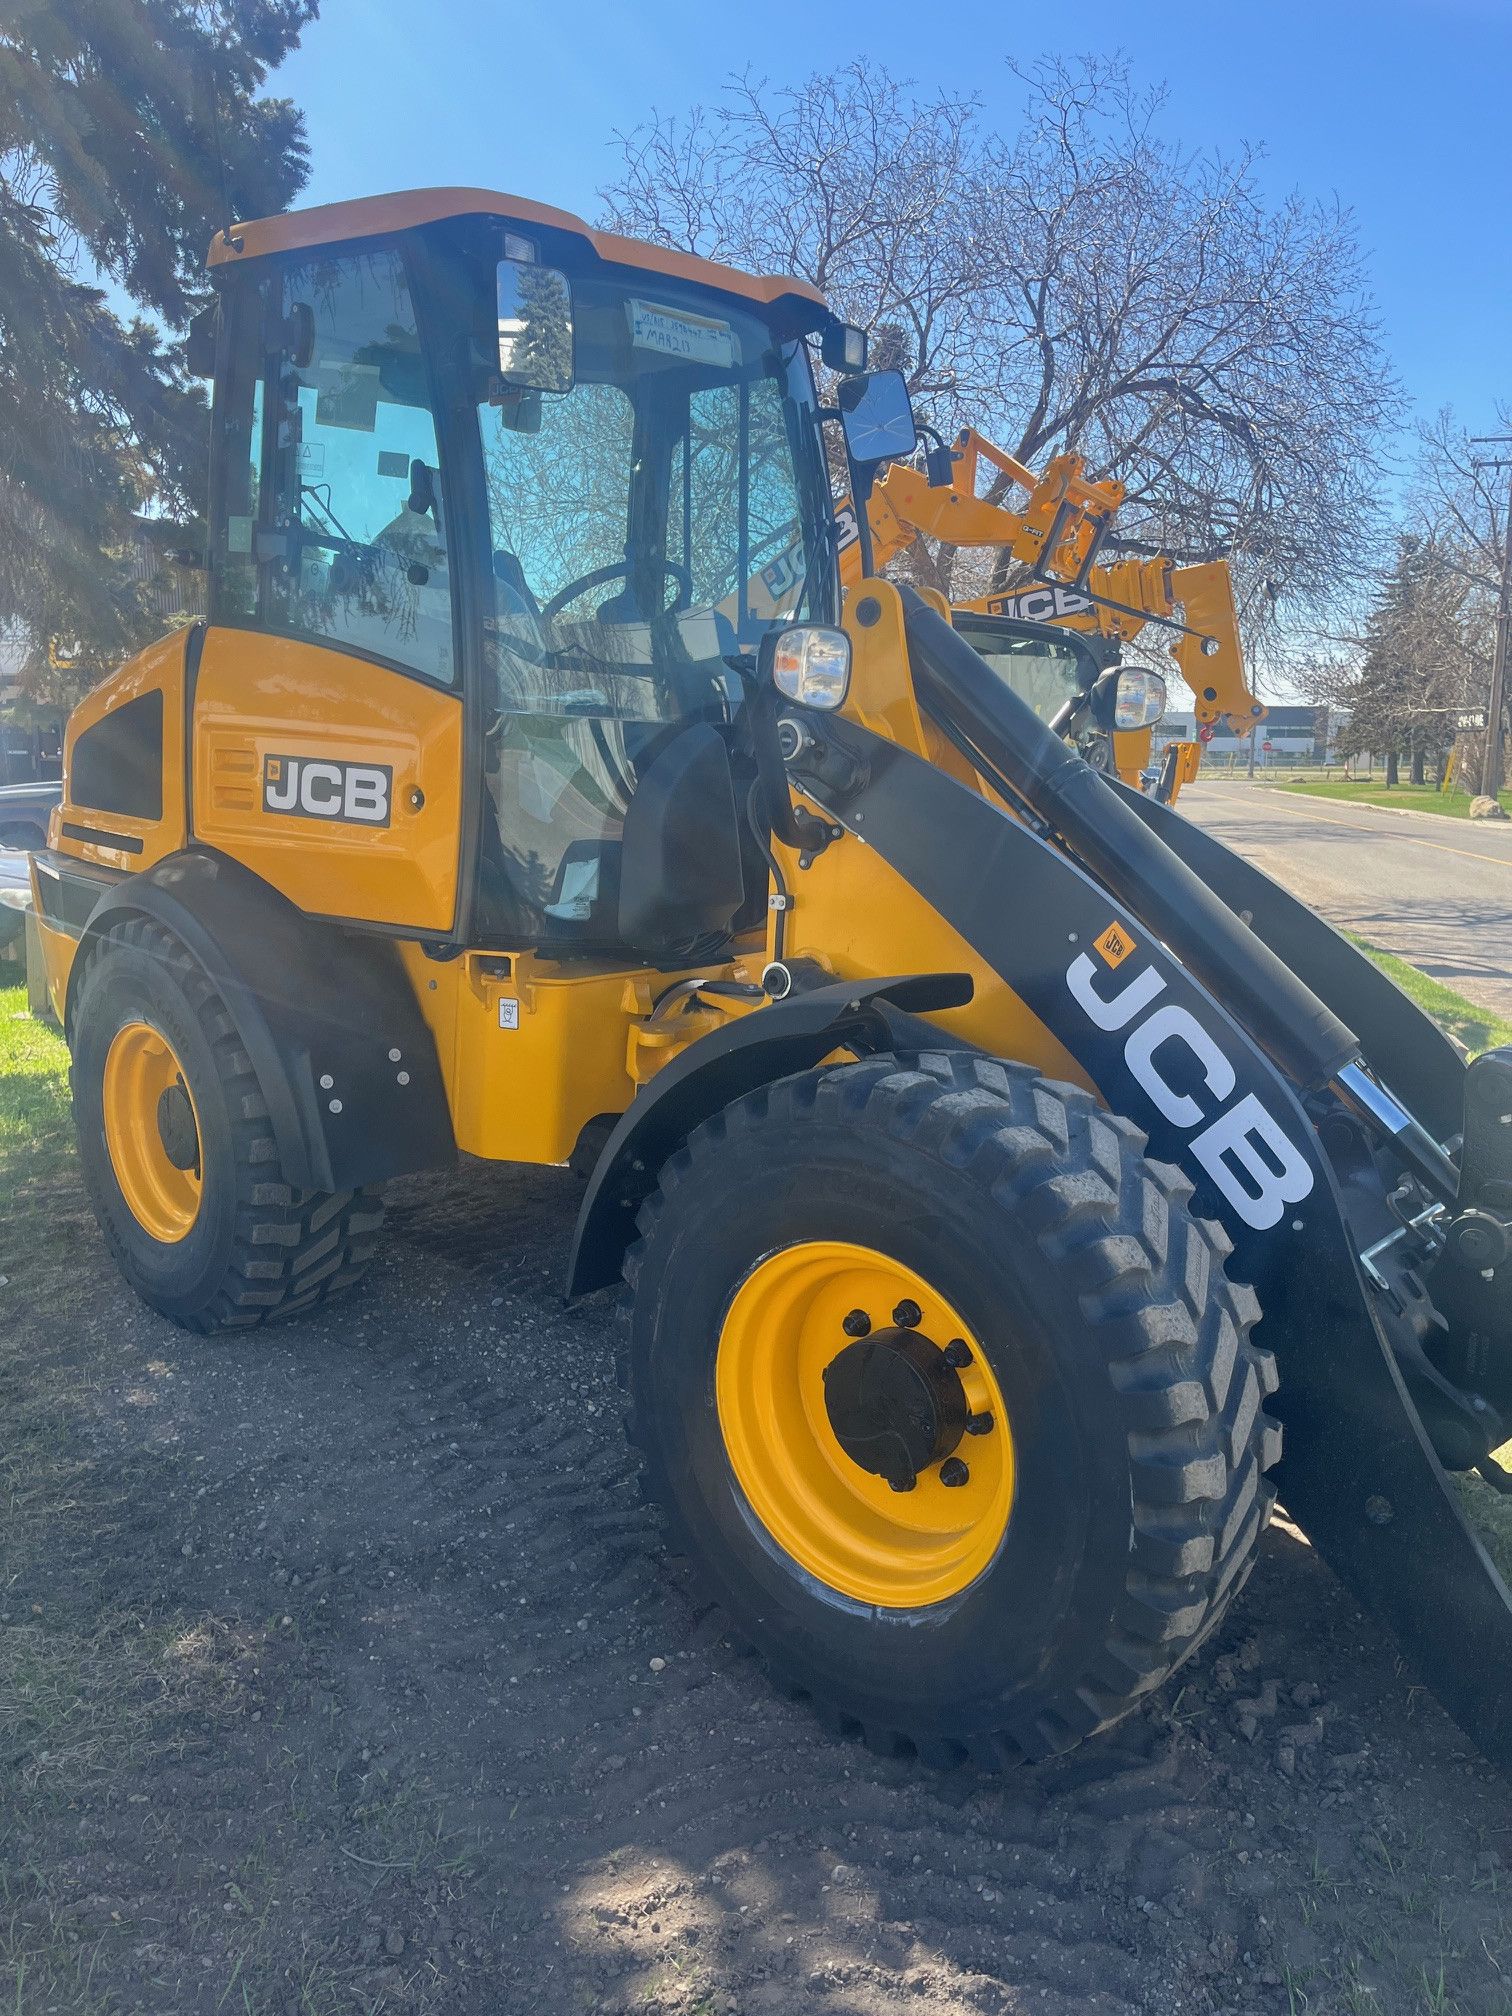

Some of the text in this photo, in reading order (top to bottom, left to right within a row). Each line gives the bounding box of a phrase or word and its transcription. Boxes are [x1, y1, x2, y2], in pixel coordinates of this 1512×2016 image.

[267, 761, 388, 821] JCB
[1105, 933, 1124, 956] JCB
[1066, 951, 1314, 1231] JCB
